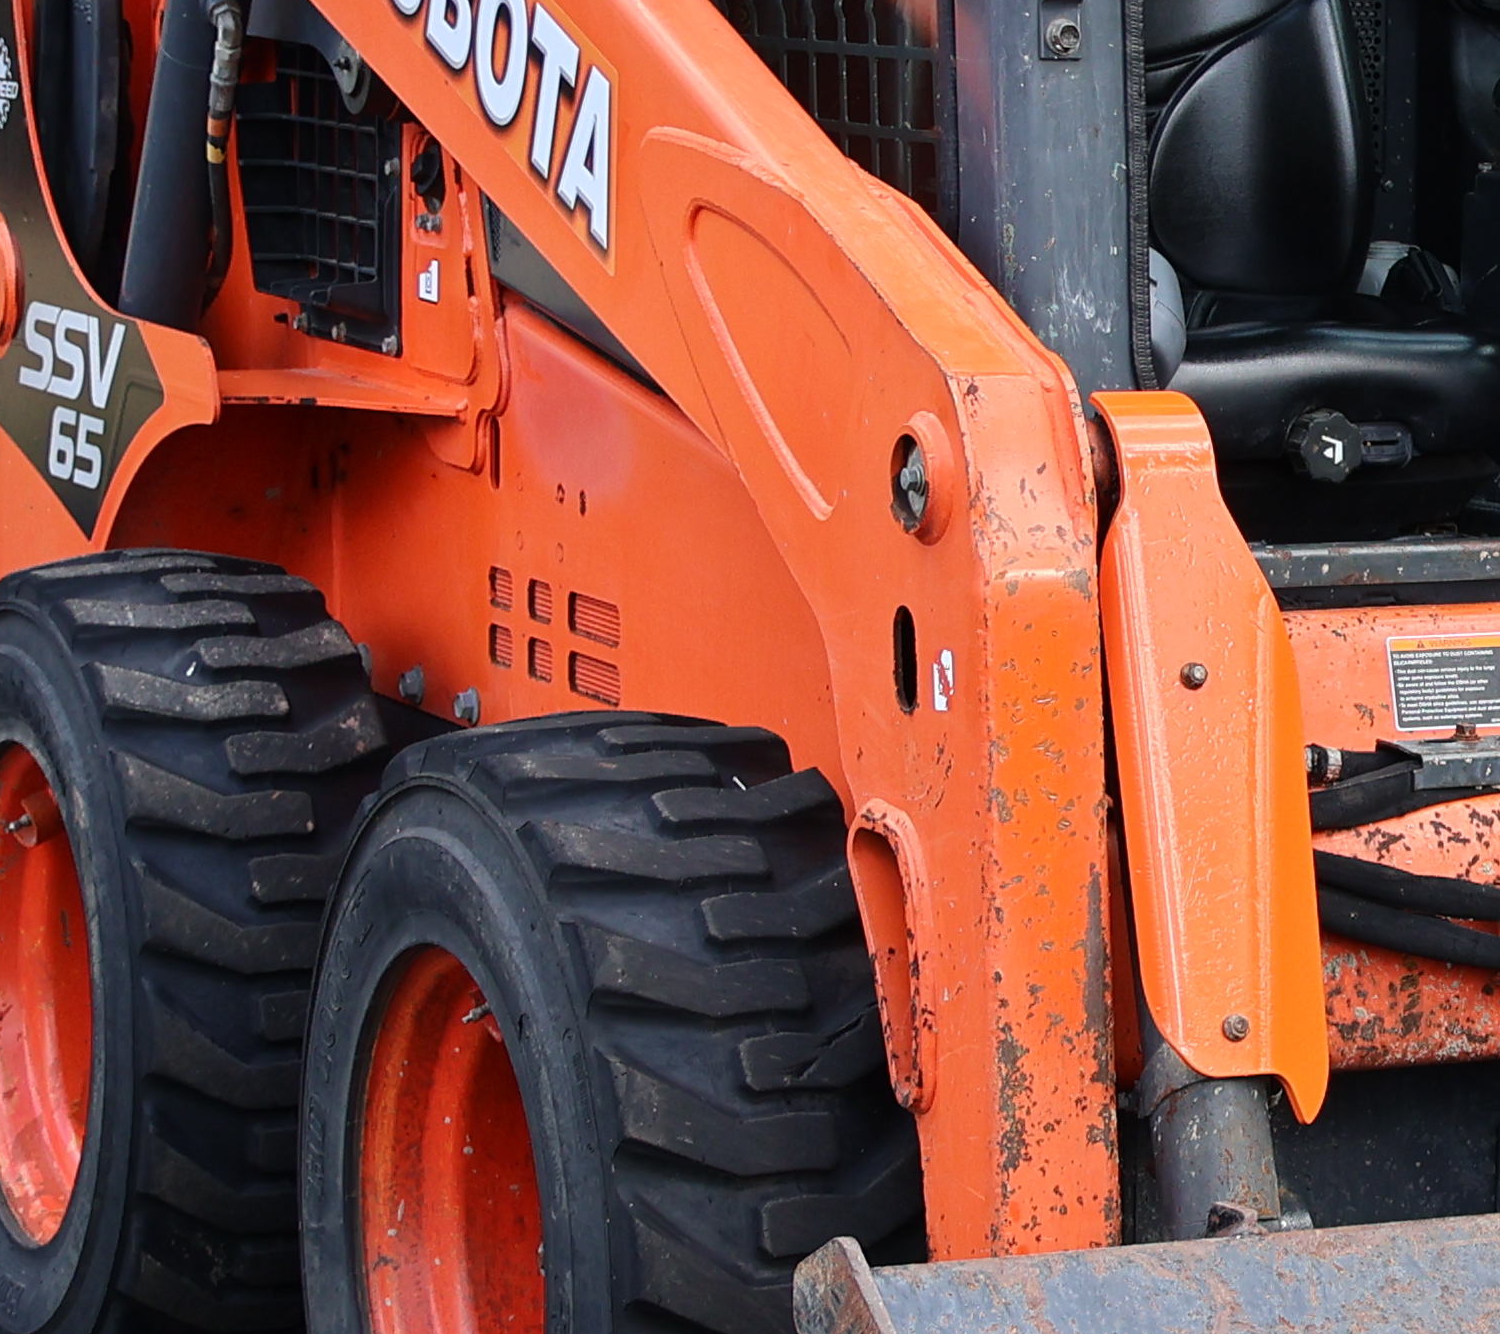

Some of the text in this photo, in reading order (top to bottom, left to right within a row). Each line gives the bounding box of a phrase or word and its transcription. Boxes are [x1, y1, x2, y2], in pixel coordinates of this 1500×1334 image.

[18, 300, 127, 410] SSV
[48, 405, 106, 490] 65
[1430, 638, 1472, 648] WARNING
